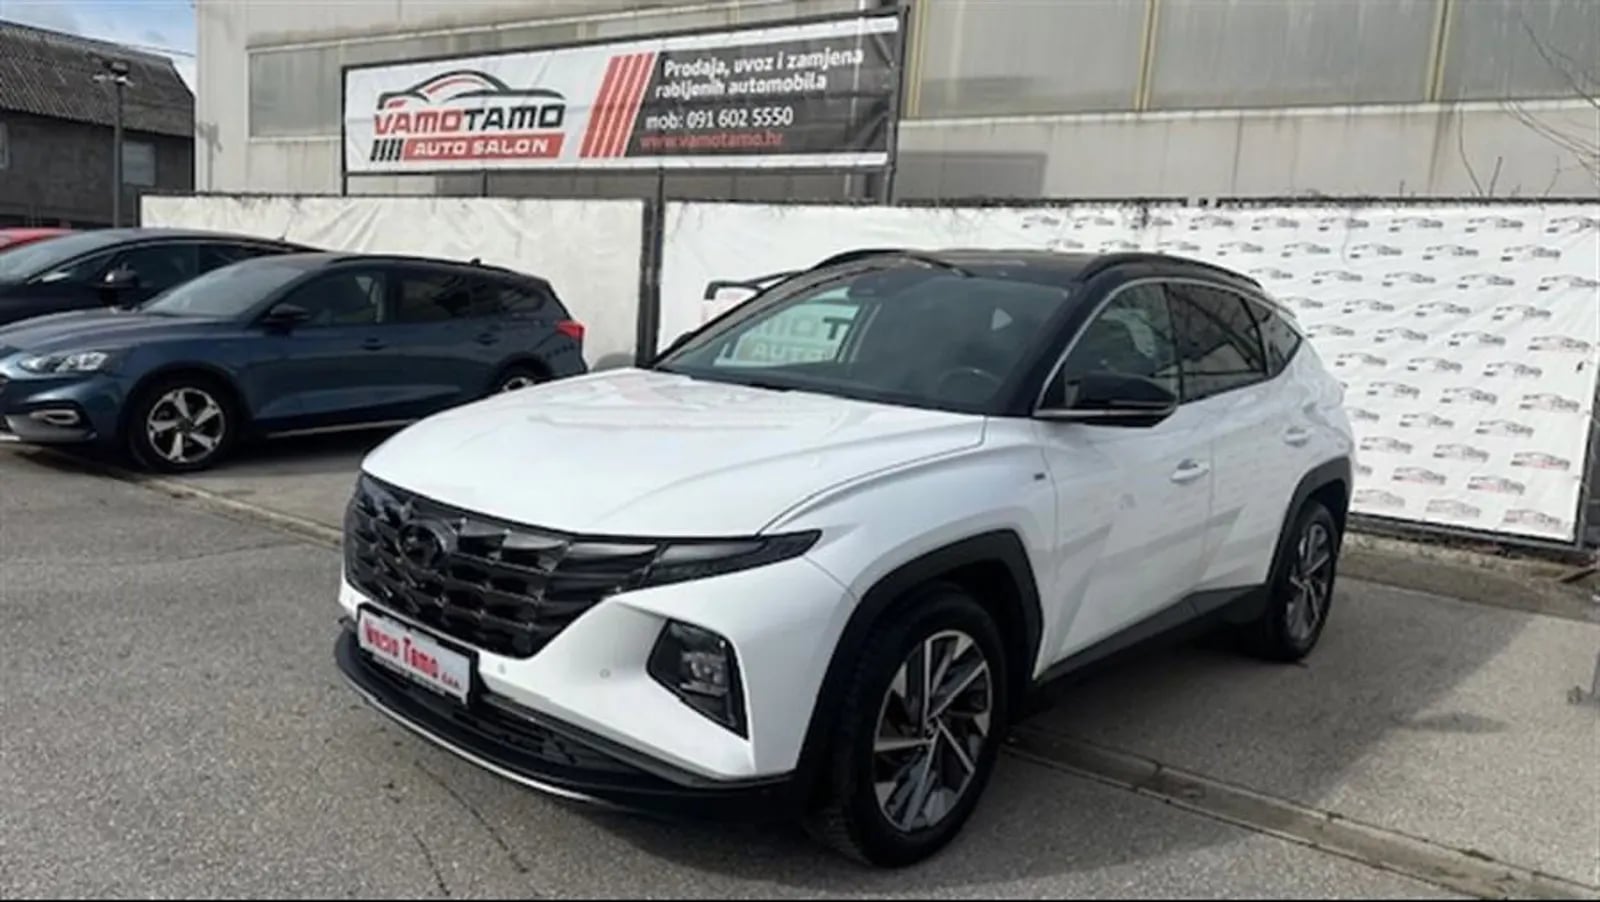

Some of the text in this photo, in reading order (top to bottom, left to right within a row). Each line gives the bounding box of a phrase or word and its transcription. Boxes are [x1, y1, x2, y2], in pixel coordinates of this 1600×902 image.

[664, 46, 864, 79] Prodaja, uvoz i zamjena
[655, 73, 827, 100] rabljenih automobila
[374, 104, 566, 135] VAMOTAMO
[645, 106, 794, 130] mob: 091 602 5550
[413, 138, 549, 156] AUTO SALON
[640, 130, 783, 149] www.vamotamo.hr
